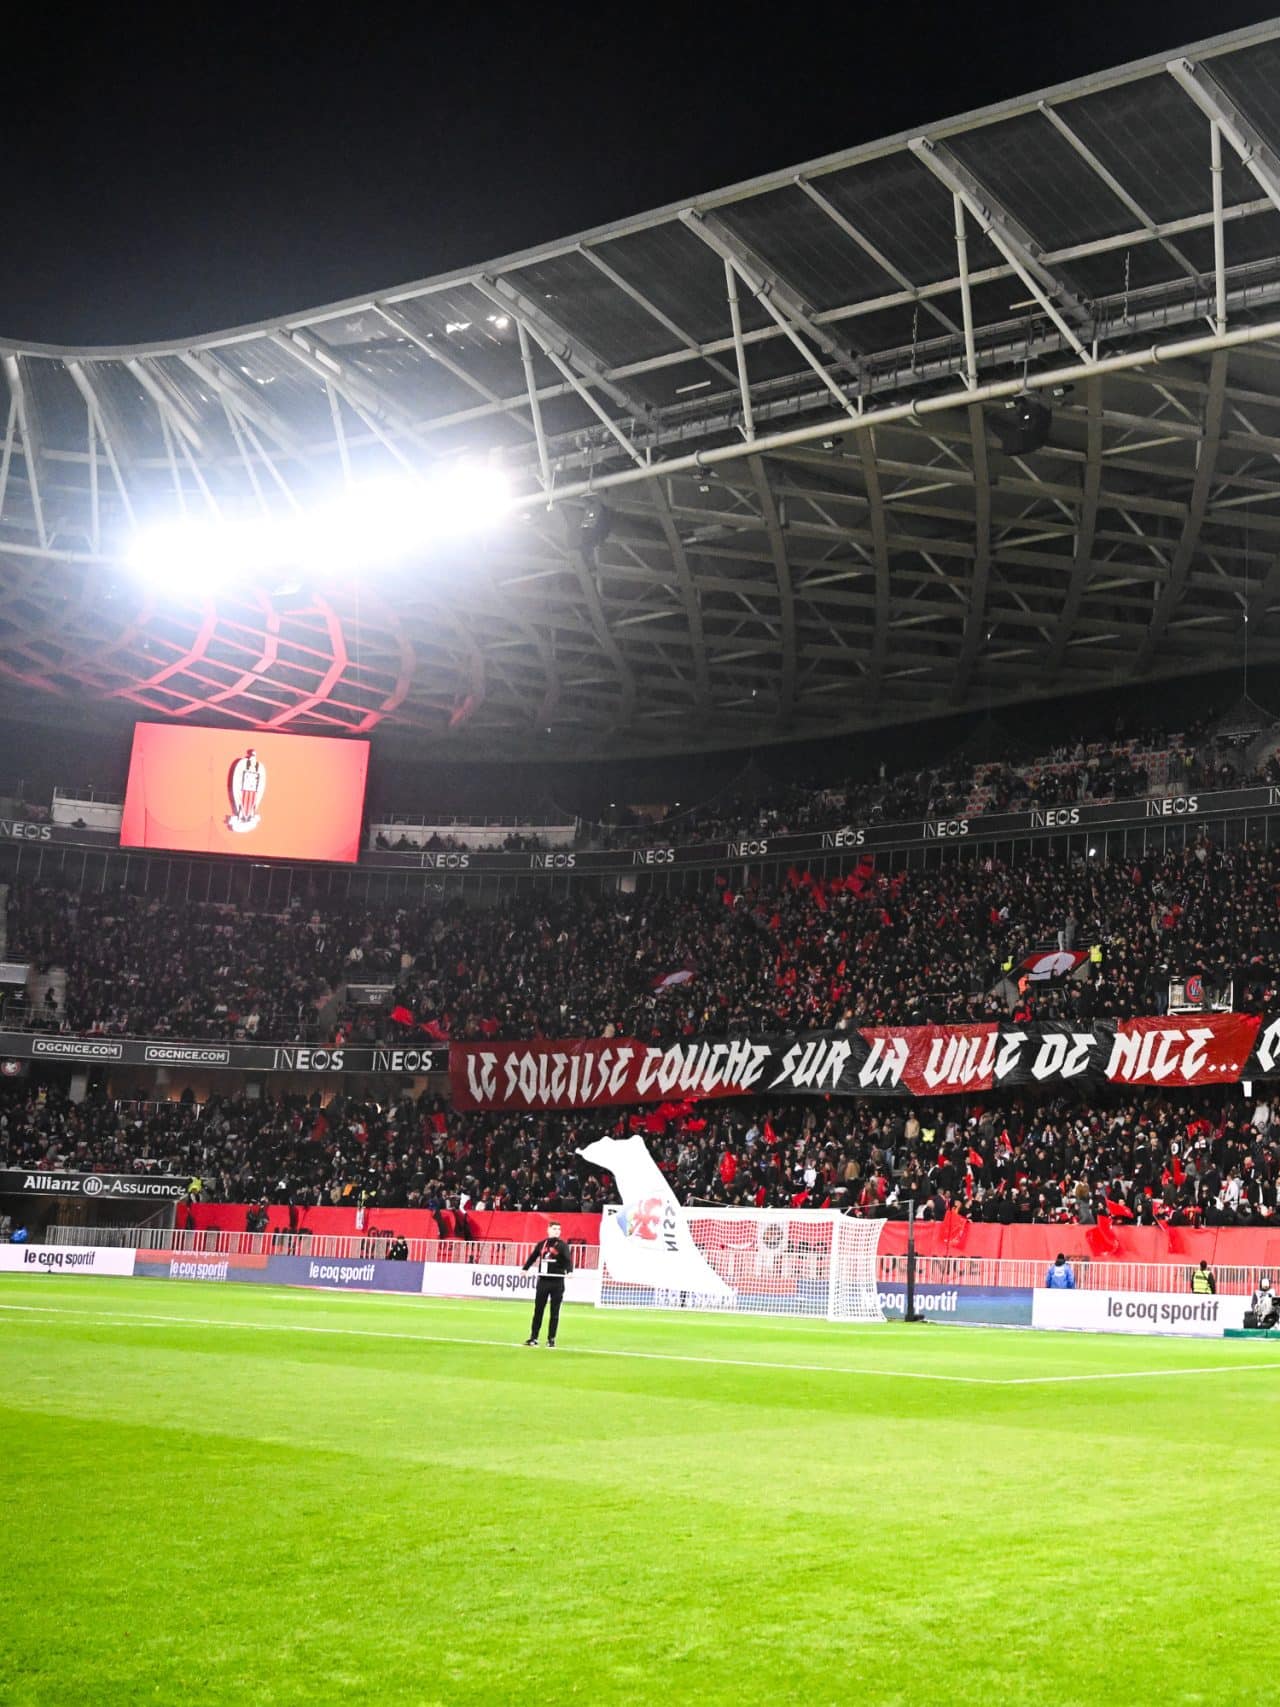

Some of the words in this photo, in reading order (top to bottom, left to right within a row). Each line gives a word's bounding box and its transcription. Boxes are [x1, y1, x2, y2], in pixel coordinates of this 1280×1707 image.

[1146, 796, 1198, 816] INEOS
[1031, 808, 1080, 827] INEOS
[923, 820, 969, 837] INEOS
[821, 830, 865, 847] INEOS
[632, 848, 675, 865] INEOS
[727, 840, 768, 857] INEOS
[421, 852, 469, 869] INEOS
[530, 853, 576, 868] INEOS
[37, 1041, 118, 1056] OGCNICE.COM
[149, 1048, 226, 1061] OGCNICE.COM
[273, 1049, 344, 1071] INEOS
[372, 1051, 433, 1071] INEOS
[467, 1052, 498, 1103] LE
[635, 1037, 774, 1096] COUCHE
[767, 1038, 852, 1089] SUR
[857, 1038, 910, 1089] LA
[1031, 1033, 1097, 1081] DE
[24, 1175, 80, 1191] Allianz
[24, 1249, 36, 1263] le
[39, 1251, 62, 1267] coq
[66, 1251, 95, 1266] sportif
[170, 1259, 178, 1275] le
[180, 1262, 196, 1277] coq
[197, 1261, 229, 1277] sportif
[309, 1262, 318, 1277] le
[320, 1265, 339, 1283] coq
[340, 1264, 375, 1283] sportif
[472, 1271, 482, 1286] le
[484, 1274, 504, 1291] coq
[506, 1274, 537, 1291] sport
[913, 1291, 958, 1315] portif
[1107, 1297, 1122, 1318] le
[1126, 1301, 1157, 1323] coq
[1160, 1300, 1219, 1324] sportif
